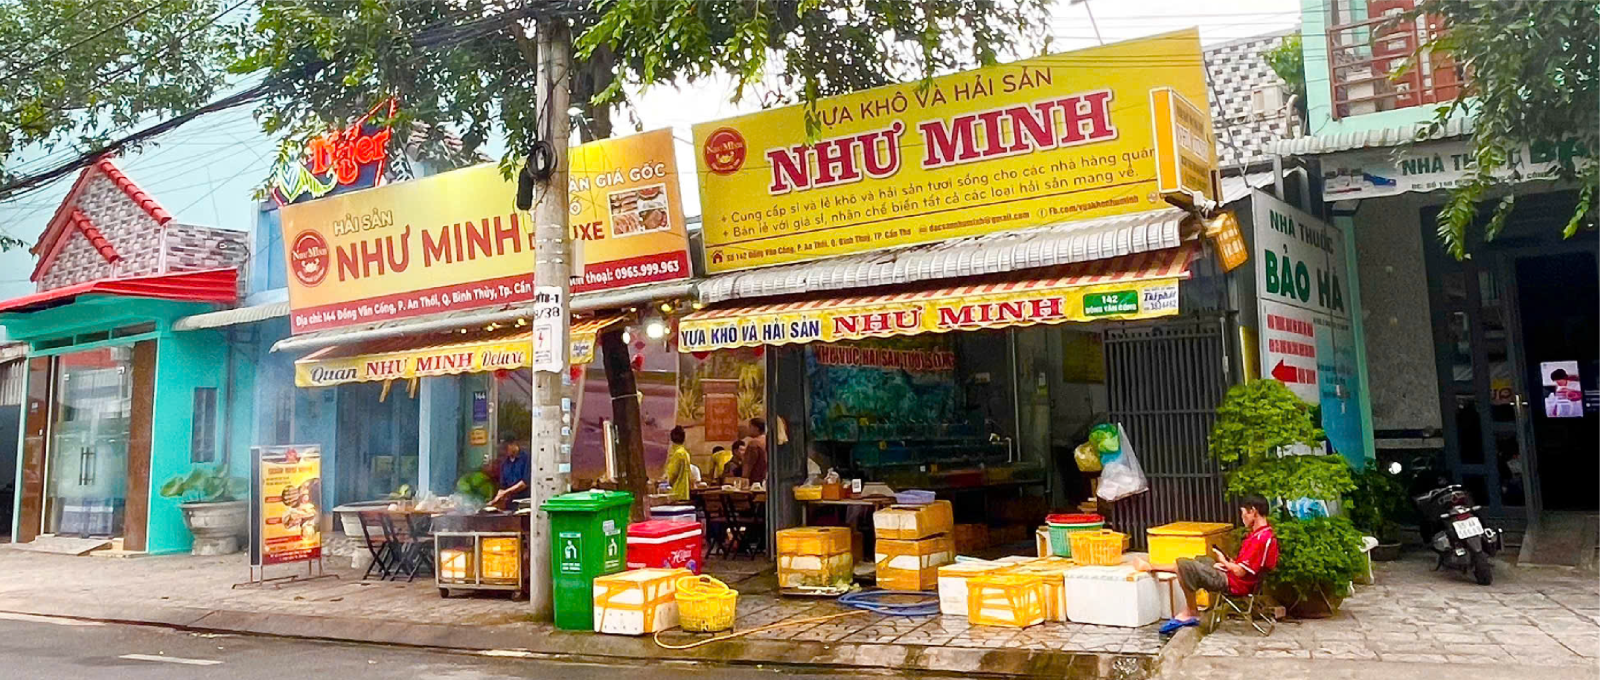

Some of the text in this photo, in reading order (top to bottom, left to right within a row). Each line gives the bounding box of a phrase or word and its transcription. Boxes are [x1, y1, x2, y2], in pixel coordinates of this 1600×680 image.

[859, 91, 908, 121] KHÔ
[914, 83, 947, 108] VÀ
[954, 73, 994, 101] HẢI
[1002, 65, 1052, 94] SẢN
[766, 121, 904, 193] NHƯ
[918, 90, 1115, 167] MINH
[1401, 152, 1445, 176] NHÀ
[333, 213, 360, 236] HẢI
[361, 208, 394, 231] SẢN
[595, 168, 625, 188] GIÁ
[628, 160, 666, 182] GỐC
[731, 211, 762, 225] Cung
[766, 204, 786, 218] cấp
[803, 200, 817, 211] và
[834, 193, 857, 207] khô
[860, 190, 875, 202] và
[878, 186, 898, 199] hải
[901, 182, 924, 196] sản
[926, 178, 953, 191] tươi
[957, 171, 989, 188] sống
[993, 168, 1018, 181] cho
[1022, 163, 1046, 177] các
[1050, 159, 1077, 173] nhà
[1080, 152, 1117, 170] hàng
[772, 218, 789, 231] với
[865, 203, 888, 217] chế
[891, 200, 919, 213] biến
[923, 194, 941, 208] tất
[945, 190, 960, 205] cả
[964, 187, 987, 201] các
[990, 184, 1015, 200] loại
[1019, 178, 1040, 192] hải
[1044, 174, 1069, 190] sản
[1073, 169, 1114, 187] mang
[335, 224, 411, 282] NHƯ
[421, 213, 522, 268] MINH
[1269, 208, 1297, 239] NHÀ
[1298, 223, 1334, 255] THUỐC
[295, 313, 308, 328] Địa
[322, 310, 336, 323] 144
[398, 299, 407, 311] P.
[407, 297, 419, 309] An
[441, 294, 452, 307] Q.
[452, 289, 472, 303] Bình
[498, 285, 513, 299] Tp.
[614, 260, 680, 280] 0965.999.963
[1101, 294, 1118, 304] 142
[1264, 243, 1345, 312] BẢO HÀ
[710, 323, 737, 344] KHÔ
[741, 321, 758, 342] VÀ
[762, 317, 785, 341] HẢI
[790, 315, 820, 338] SẢN
[833, 297, 1064, 334] NHƯ MINH
[310, 349, 525, 383] Quán NHƯ MINH Deluxe
